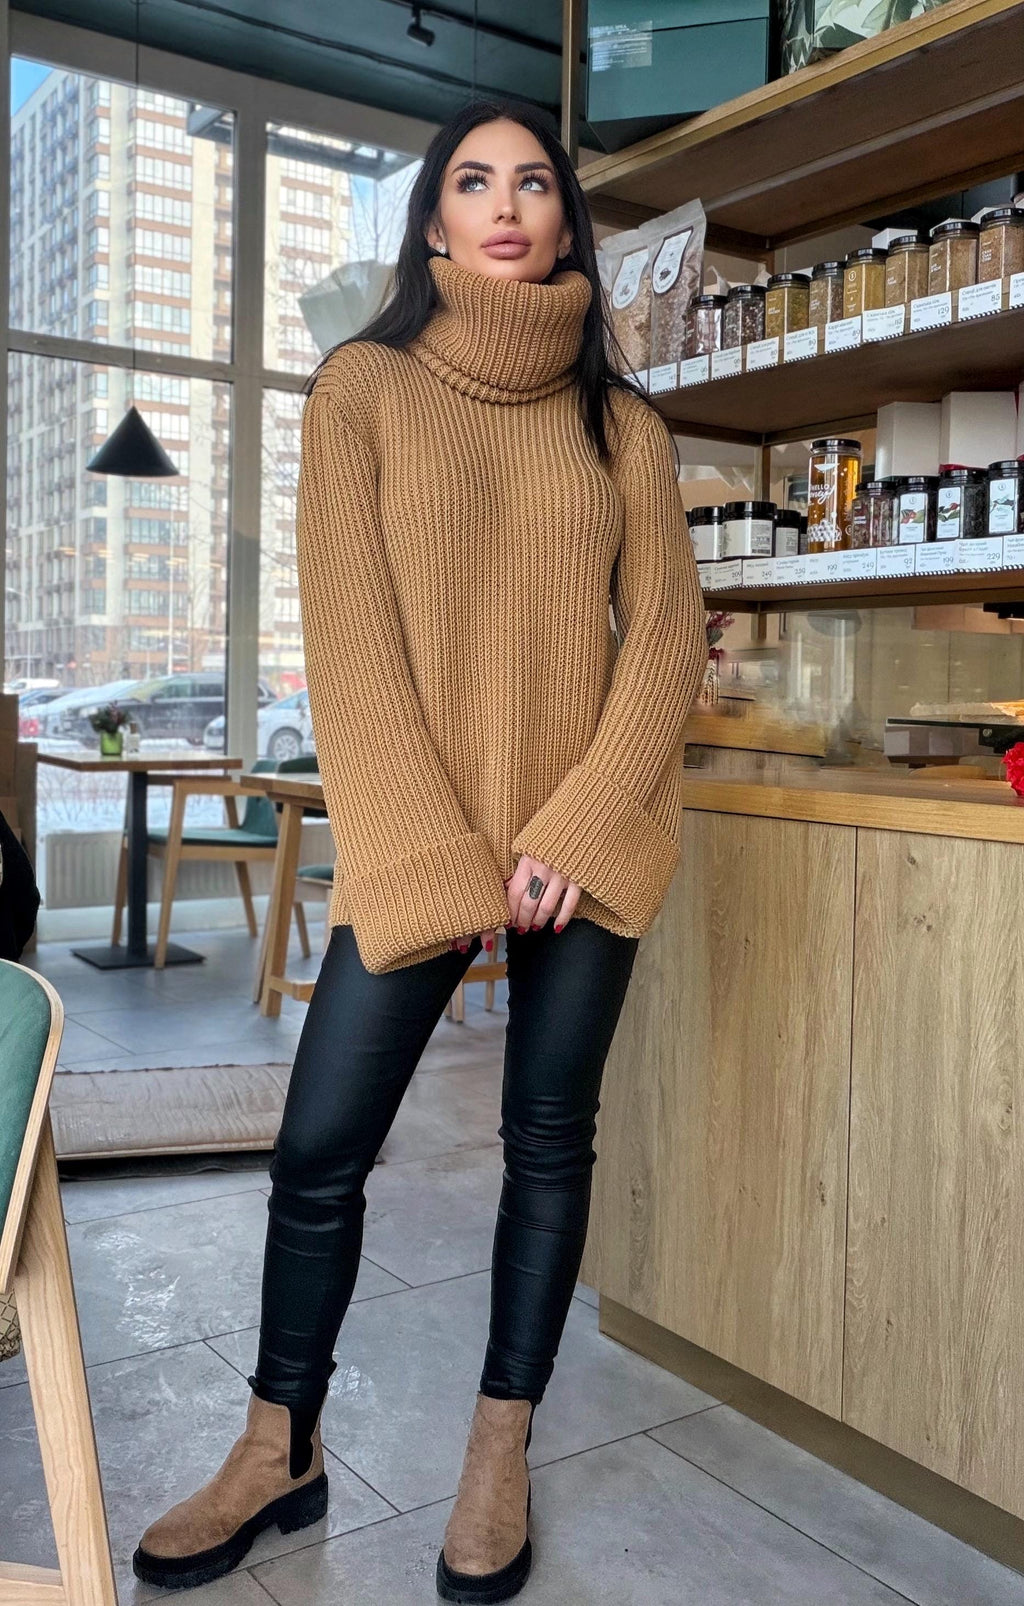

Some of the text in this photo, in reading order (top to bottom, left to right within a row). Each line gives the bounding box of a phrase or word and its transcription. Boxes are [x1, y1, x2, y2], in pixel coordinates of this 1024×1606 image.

[991, 294, 1000, 302] 85
[937, 306, 950, 316] 129
[986, 552, 1000, 561] 229
